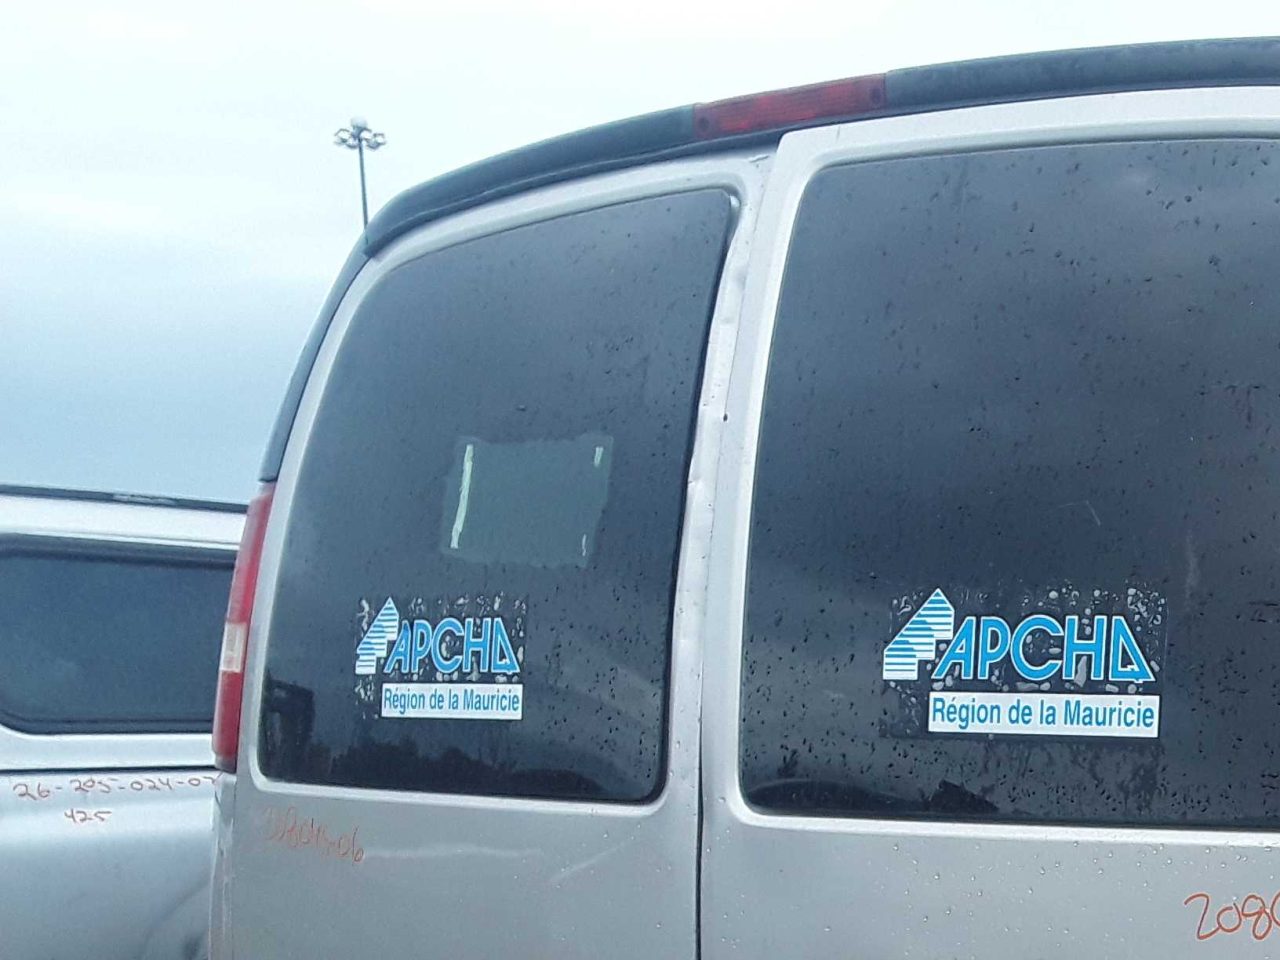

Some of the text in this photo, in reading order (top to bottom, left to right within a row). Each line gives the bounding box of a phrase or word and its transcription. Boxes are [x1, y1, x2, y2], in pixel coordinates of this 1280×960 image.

[384, 687, 520, 715] Région de la Mauricie
[932, 698, 1155, 730] Région de la Mauricie
[64, 807, 112, 823] 425
